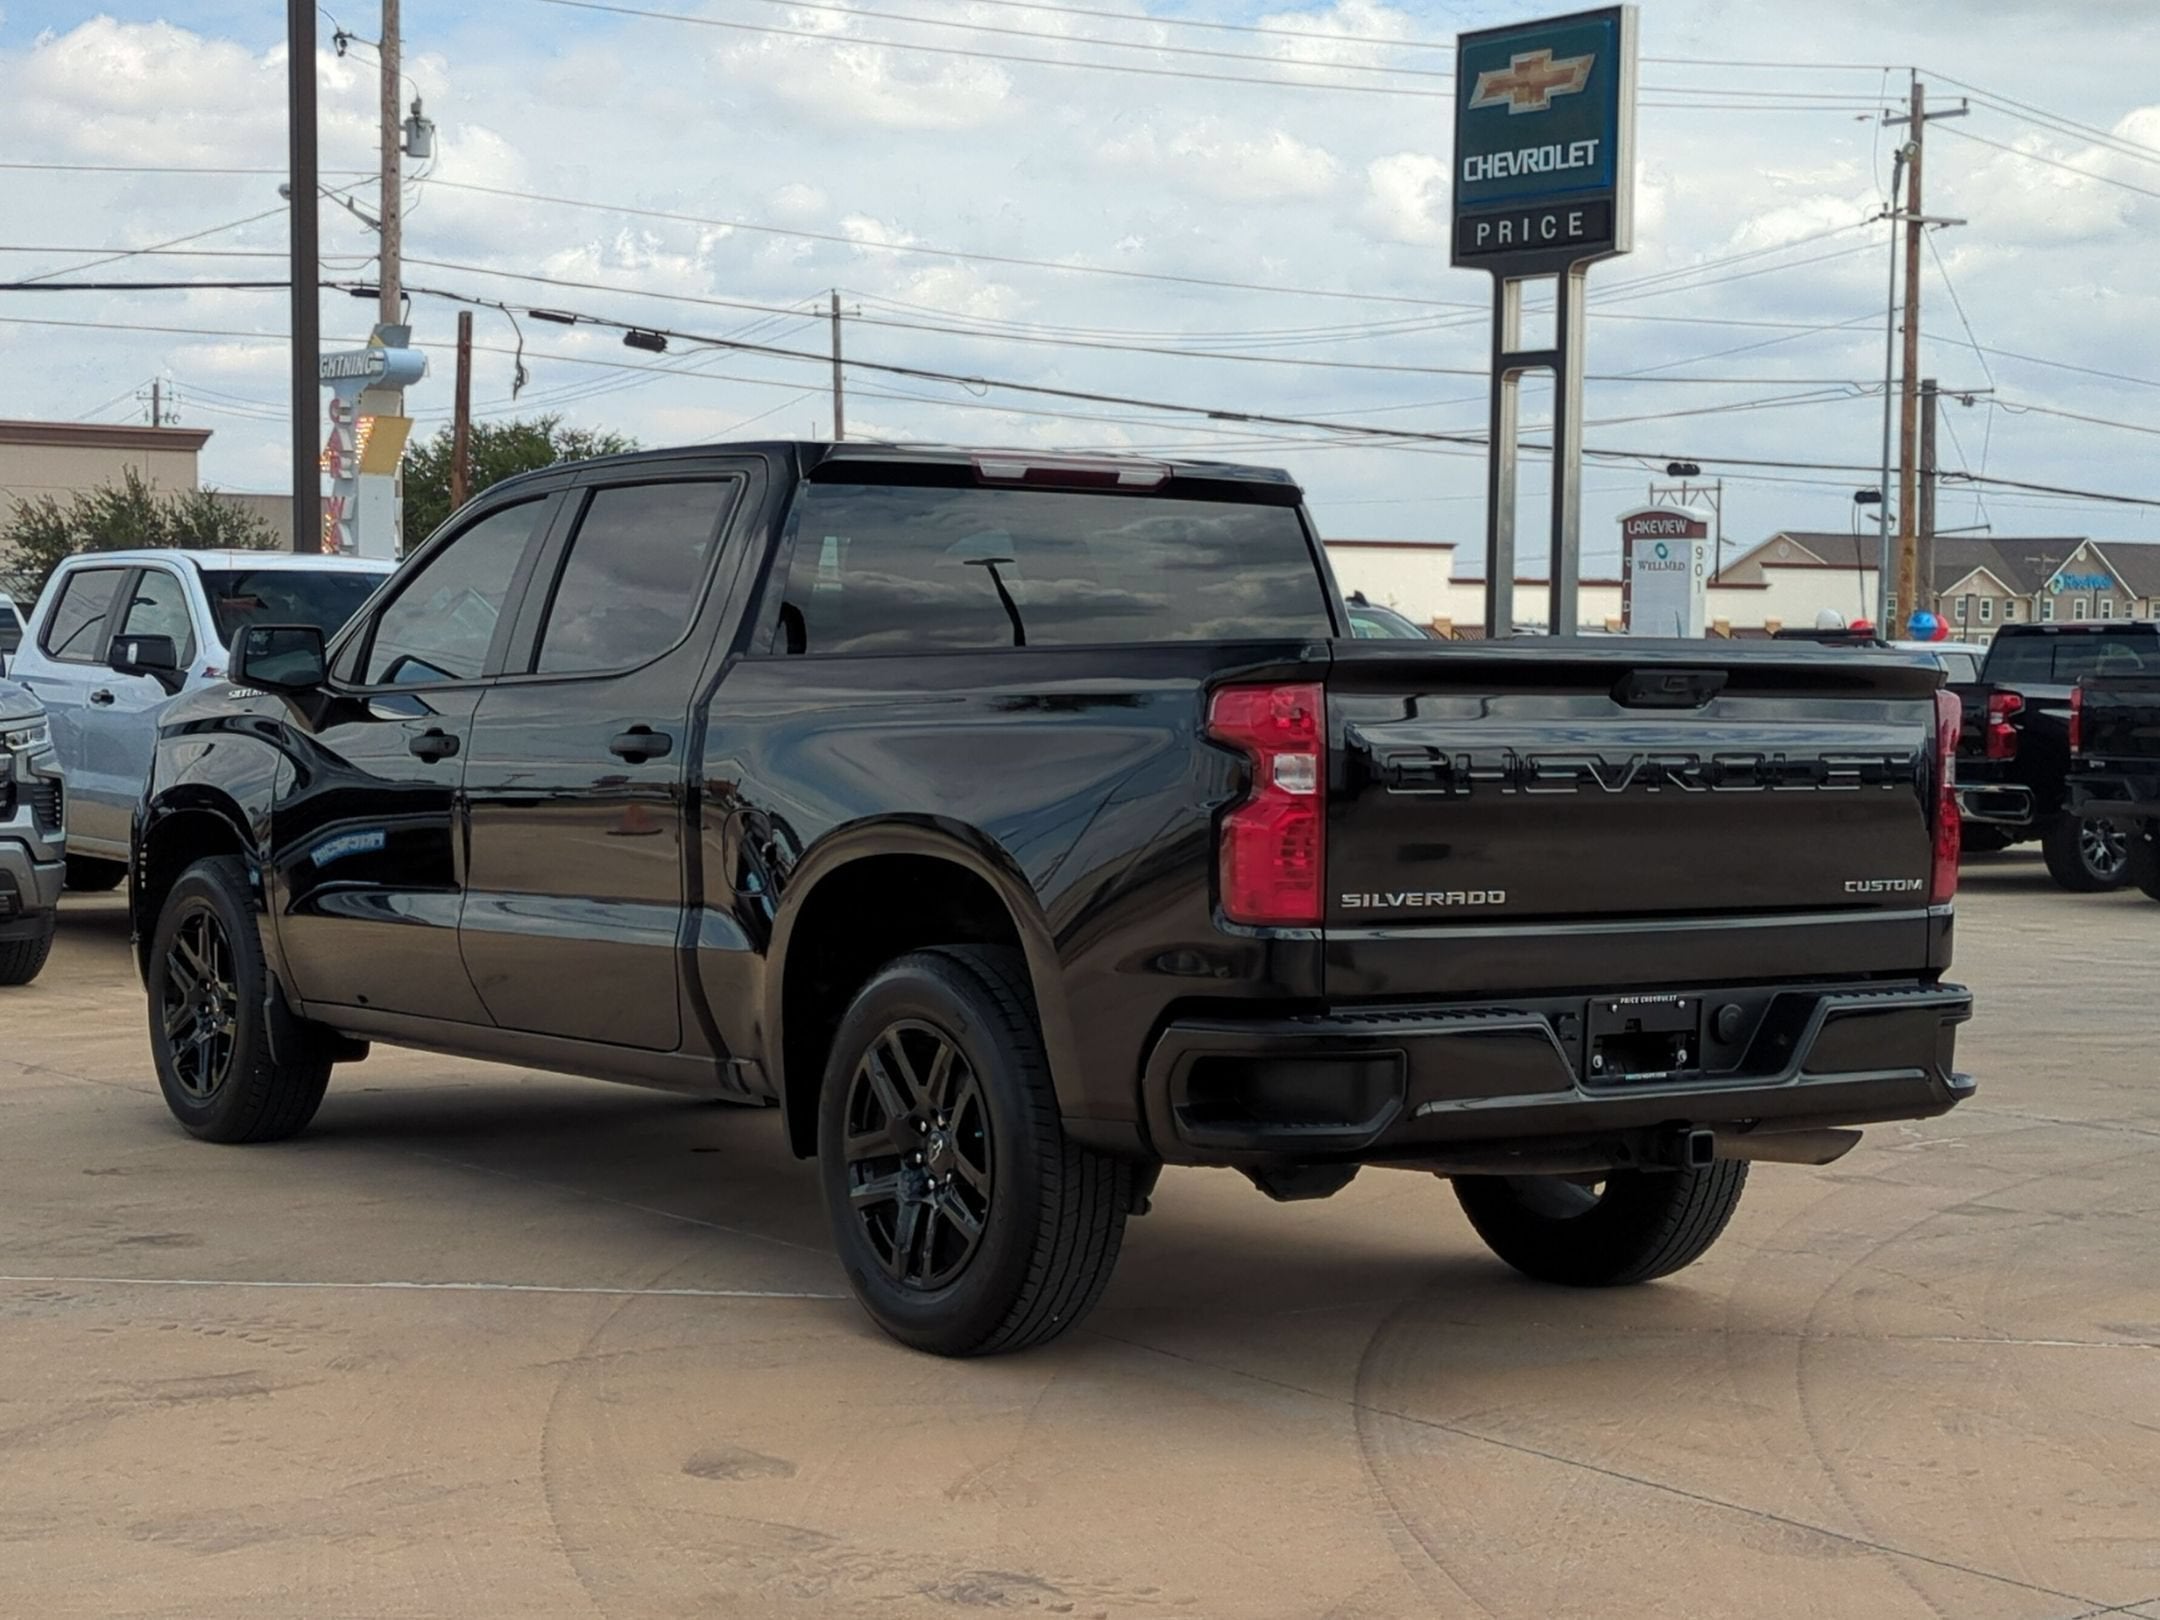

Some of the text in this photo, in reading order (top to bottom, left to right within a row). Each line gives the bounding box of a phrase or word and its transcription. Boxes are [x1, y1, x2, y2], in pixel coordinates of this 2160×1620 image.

[1463, 139, 1599, 181] CHEVROLET
[1477, 212, 1583, 246] PRICE
[319, 350, 374, 378] GHTNING
[1627, 520, 1687, 535] LAKEVIEW
[1695, 546, 1704, 594] 901
[1387, 751, 1911, 794] CHEVROLET
[1340, 890, 1506, 908] SILVERADO
[1843, 879, 1923, 893] CUSTOM
